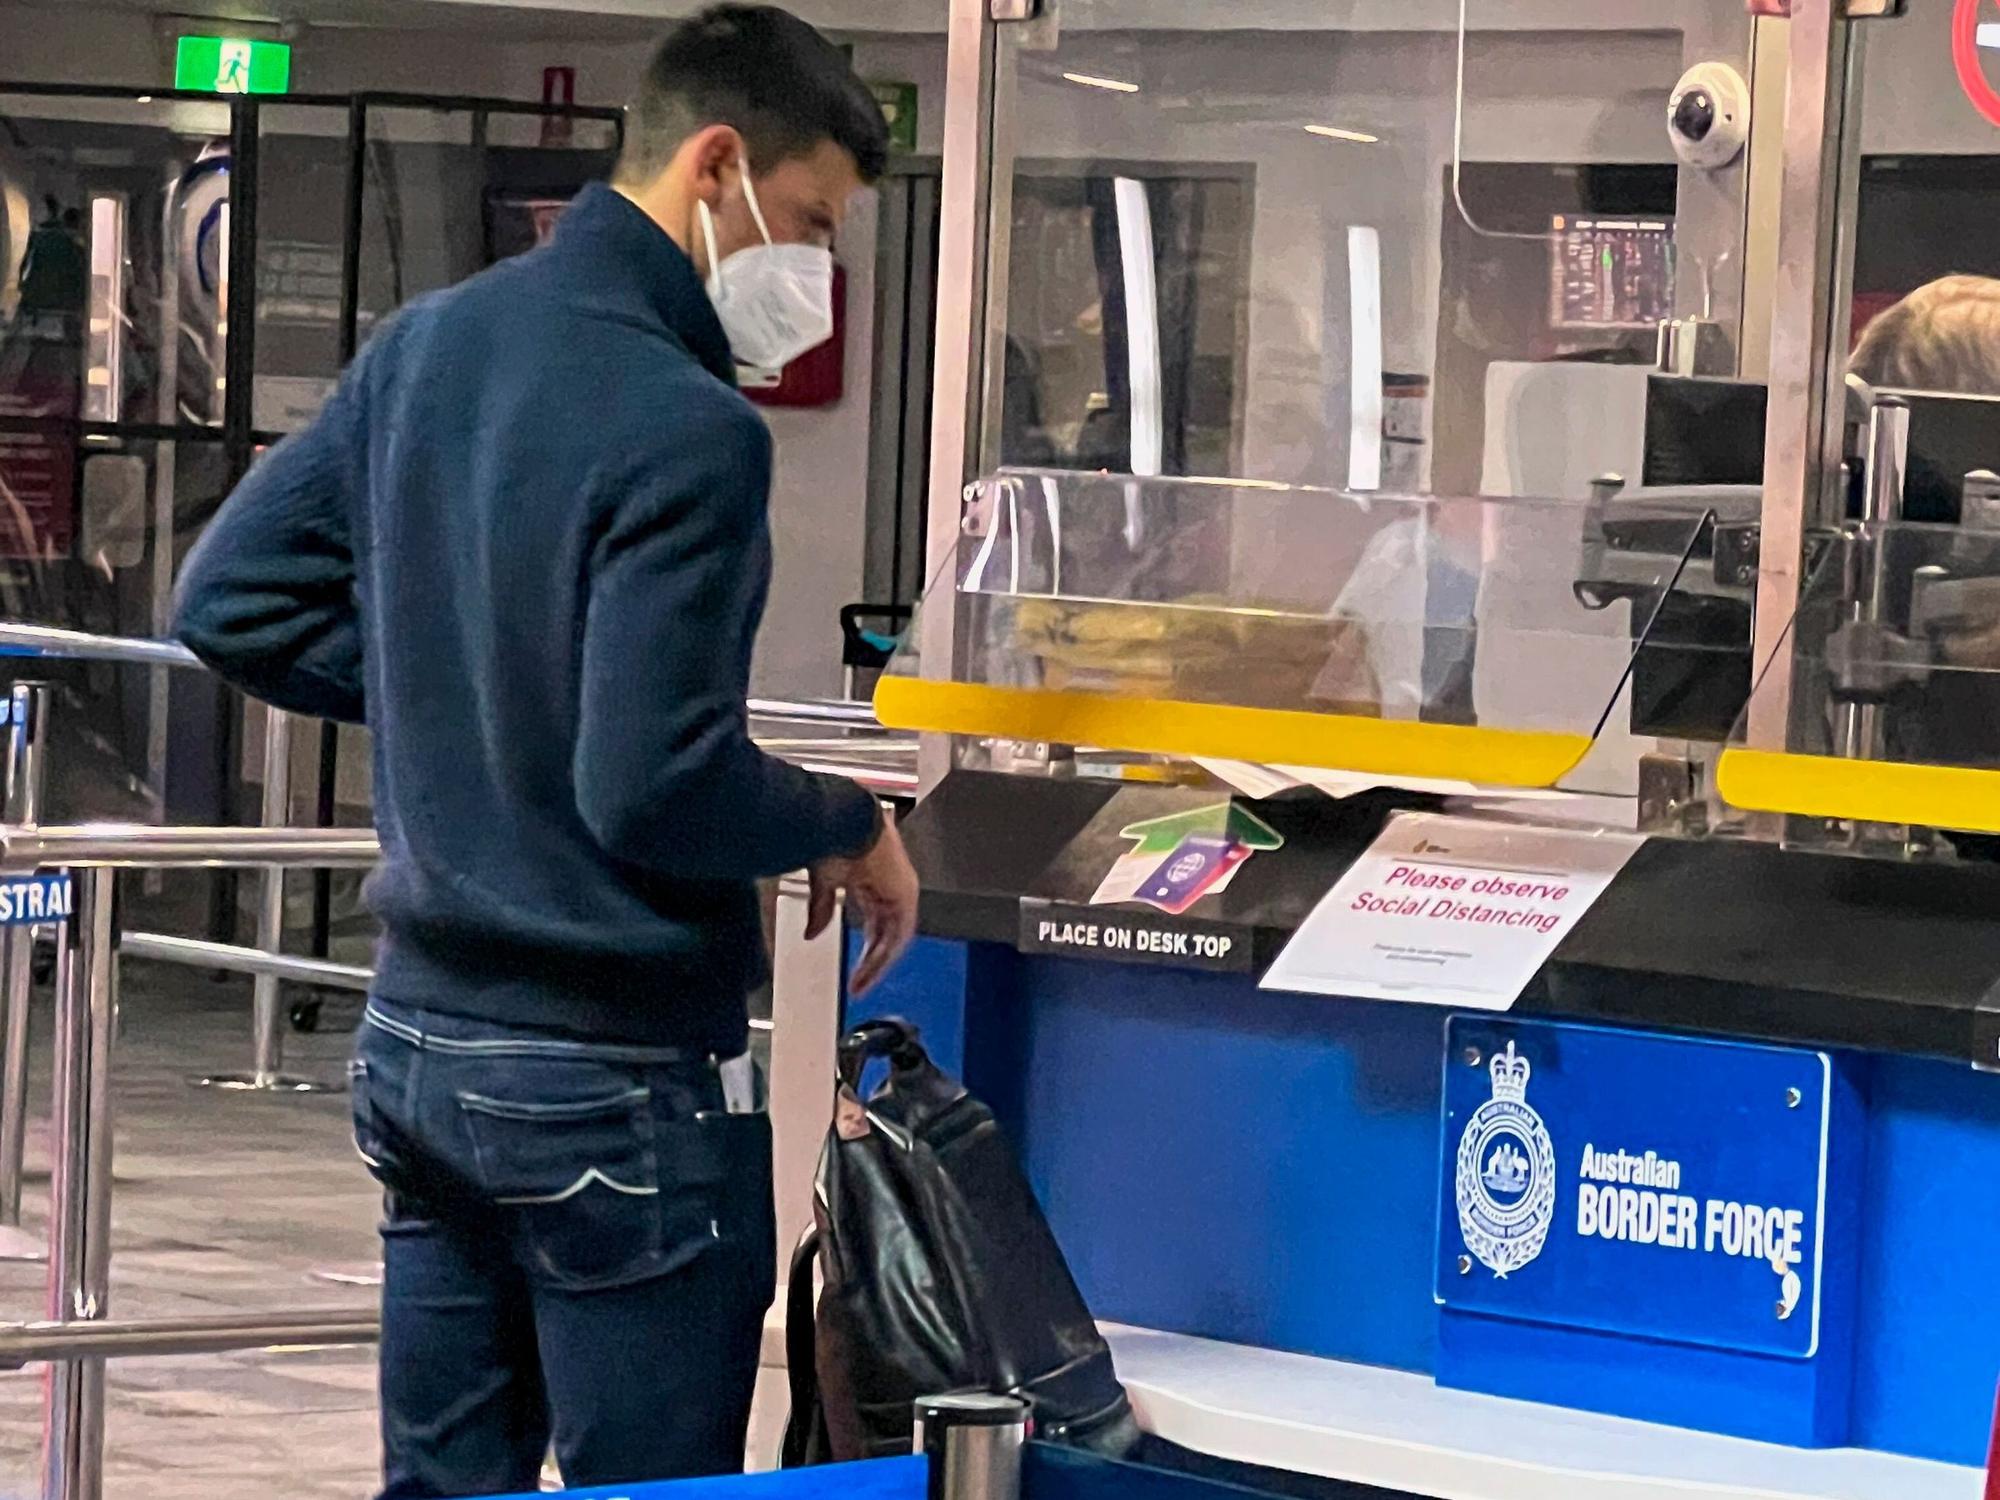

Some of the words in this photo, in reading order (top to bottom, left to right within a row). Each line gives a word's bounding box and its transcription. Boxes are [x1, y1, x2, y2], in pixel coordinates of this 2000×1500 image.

[1384, 866, 1466, 893] Please
[1471, 876, 1570, 901] observe
[1350, 891, 1430, 917] Social
[1428, 899, 1561, 934] Distancing
[1038, 921, 1098, 946] PLACE
[1103, 926, 1131, 949] ON
[1136, 929, 1188, 954] DESK
[1192, 934, 1232, 958] TOP
[1579, 1142, 1681, 1190] Australian
[1577, 1182, 1699, 1250] BORDER
[1703, 1199, 1804, 1265] FORCE
